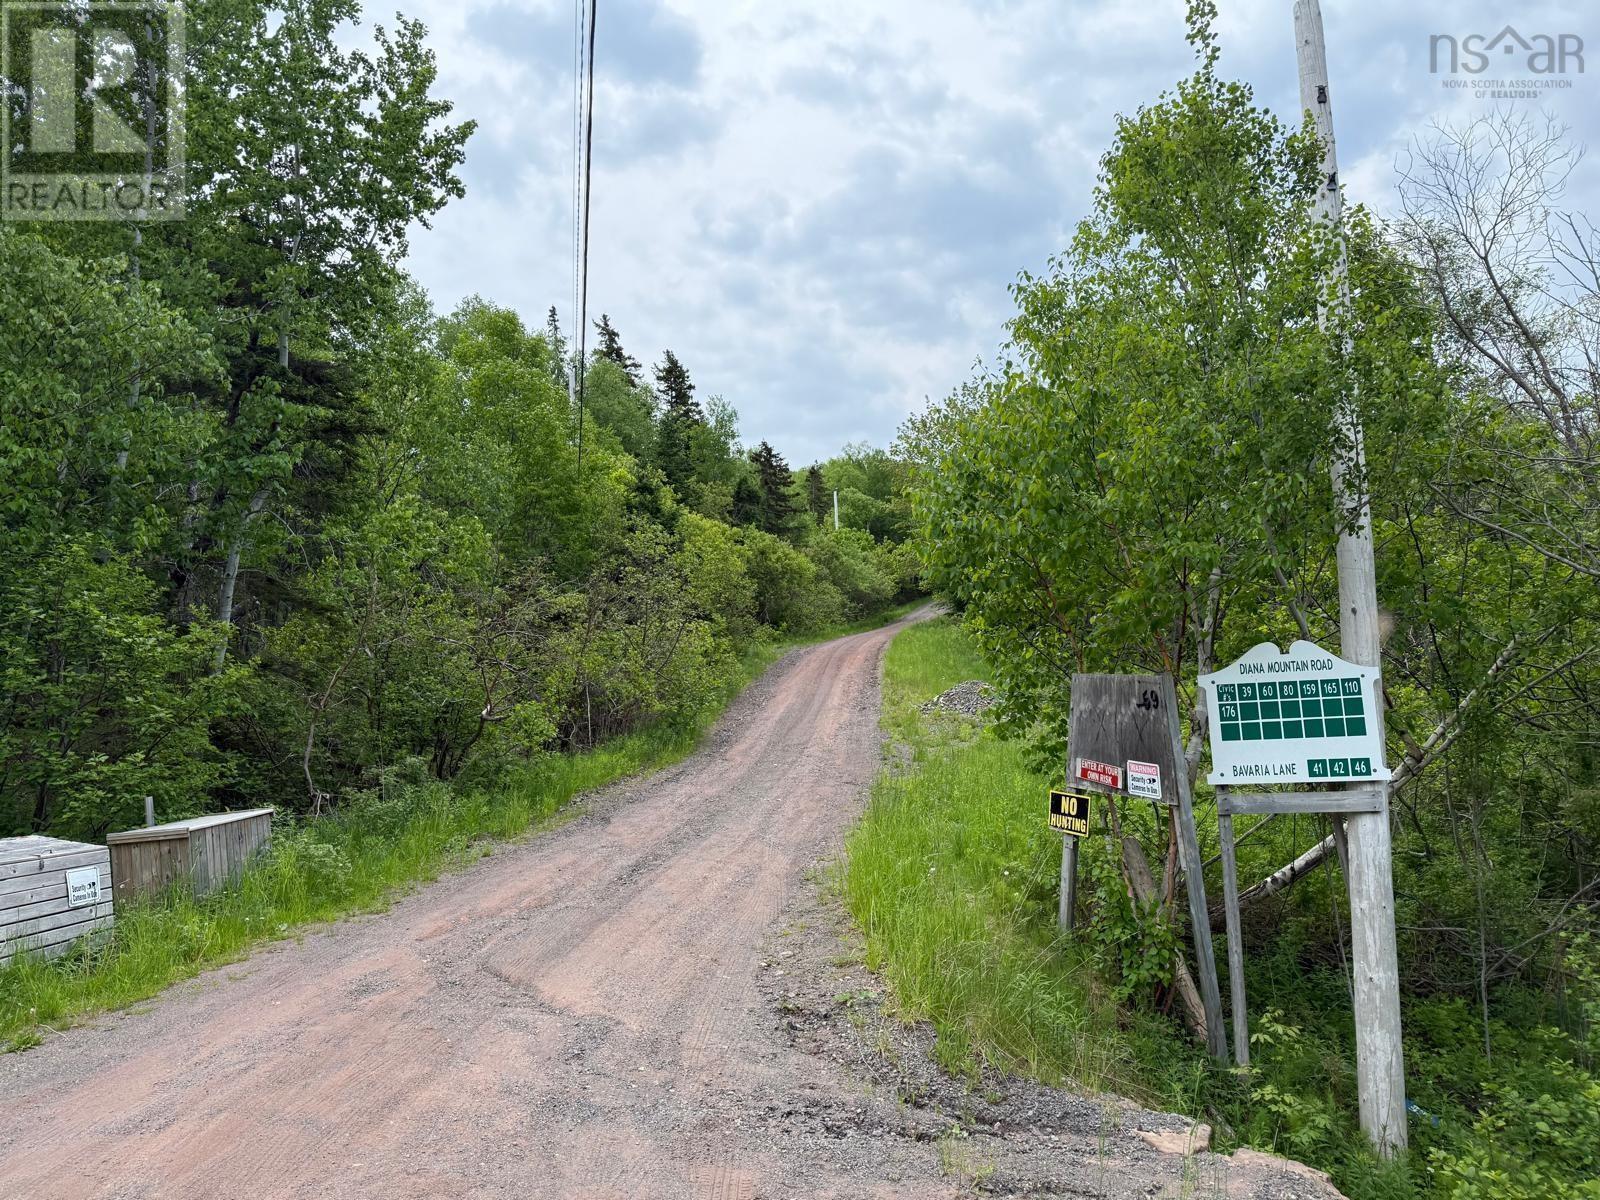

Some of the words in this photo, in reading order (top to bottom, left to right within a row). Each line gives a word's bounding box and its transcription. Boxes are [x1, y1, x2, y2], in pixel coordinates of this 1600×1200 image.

[1239, 662, 1265, 675] DIANA
[1267, 660, 1309, 673] MOUNTAIN
[1310, 658, 1333, 672] ROAD
[1218, 685, 1234, 693] Civic
[1242, 686, 1252, 698] 39
[1262, 685, 1273, 697] 60
[1283, 684, 1294, 696] 80
[1302, 683, 1316, 695] 159
[1323, 682, 1337, 694] 165
[1344, 680, 1359, 693] 110
[1221, 705, 1236, 718] 176
[1081, 760, 1097, 771] ENTER
[1098, 763, 1104, 773] AT
[1105, 764, 1118, 776] YOUR
[1129, 763, 1157, 775] WARNING
[1232, 764, 1270, 777] BAVARIA
[1273, 763, 1297, 776] LANE
[1313, 762, 1323, 775] 41
[1333, 761, 1345, 774] 42
[1354, 761, 1366, 773] 46
[1087, 770, 1100, 781] OWN
[1100, 774, 1112, 785] RISK
[1131, 774, 1146, 785] Security
[1132, 783, 1147, 792] Cameras
[1061, 795, 1078, 815] NO
[1050, 813, 1087, 833] HUNTING
[72, 884, 86, 893] Security
